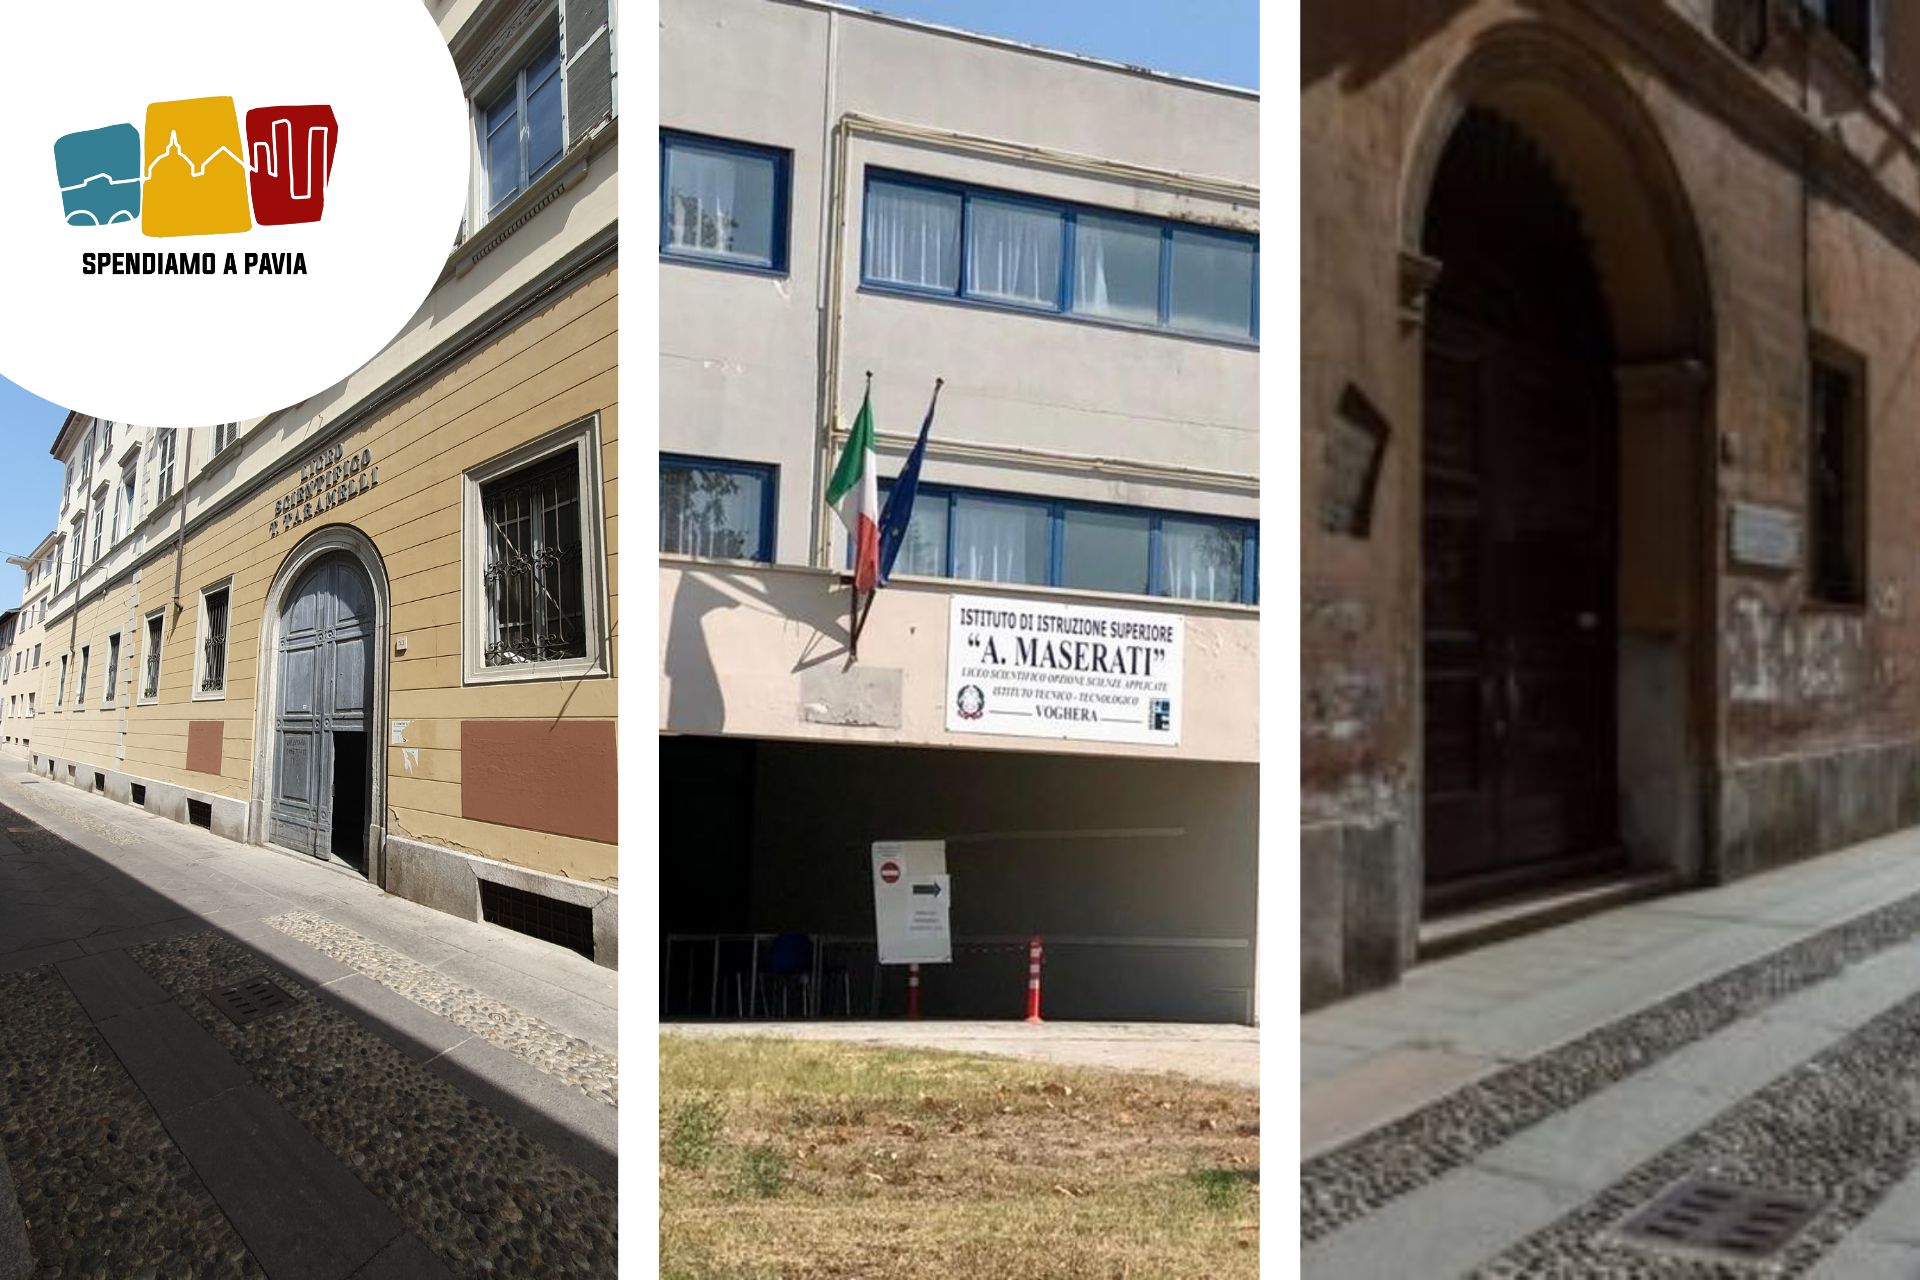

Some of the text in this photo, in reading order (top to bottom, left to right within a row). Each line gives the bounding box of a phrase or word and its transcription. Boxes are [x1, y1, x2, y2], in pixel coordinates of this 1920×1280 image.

[300, 443, 344, 481] LICEO
[274, 448, 371, 517] SCIENTIFICO
[283, 466, 379, 531] TARAMELLI
[960, 608, 1174, 643] ISTITUTO DI ISTRUZIONE SUPERIORE
[961, 667, 1168, 692] LICEO SCIENTIFICO OPZIONE SCIENZE APPLICATE
[992, 686, 1034, 699] ISTITUTO
[1035, 689, 1073, 702] TECNICO
[1079, 692, 1140, 706] TECNOLOGICO
[1035, 704, 1099, 723] VOGHERA
